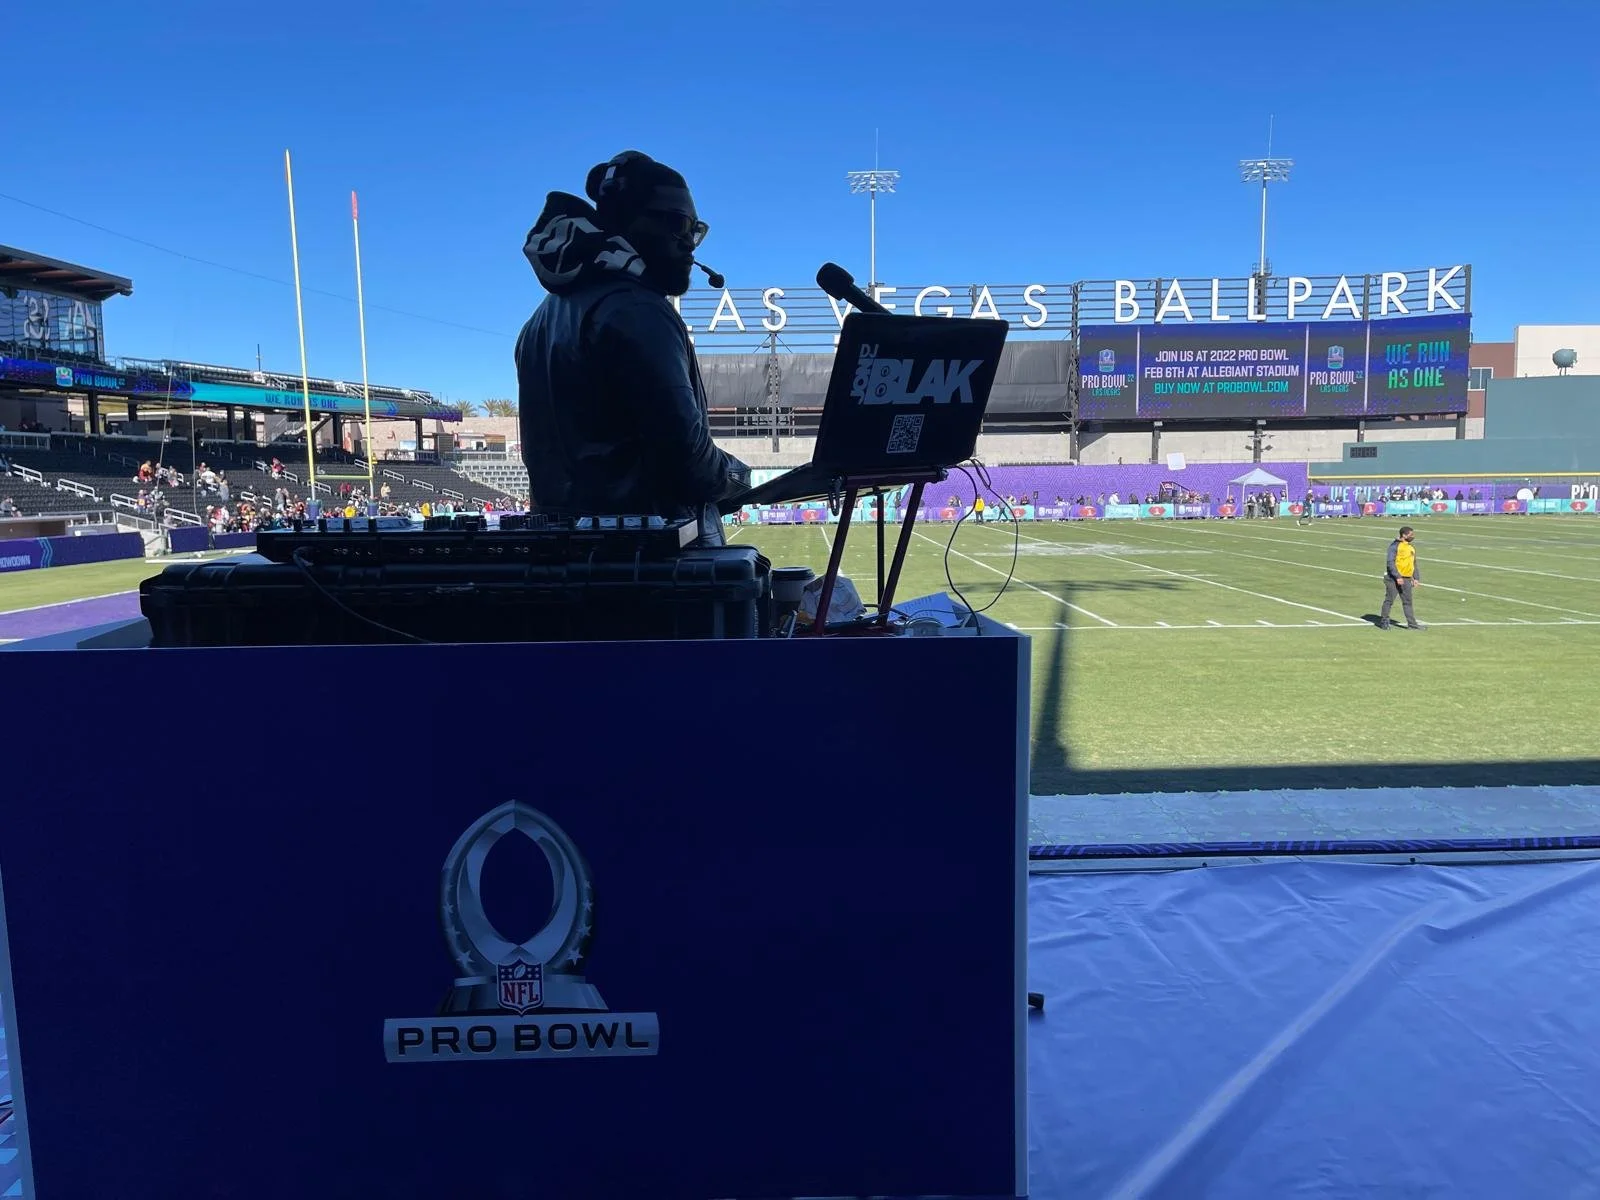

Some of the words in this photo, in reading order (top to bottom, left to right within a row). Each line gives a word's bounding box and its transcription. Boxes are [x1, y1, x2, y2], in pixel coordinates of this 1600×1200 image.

[1114, 264, 1463, 323] BALLPARK
[859, 343, 879, 358] DJ
[1155, 350, 1178, 362] JOIN
[1180, 350, 1194, 362] US
[1196, 350, 1208, 362] AT
[1210, 350, 1236, 362] 2022
[1238, 349, 1258, 361] PRO
[1260, 348, 1289, 361] BOWL
[1386, 343, 1412, 365] WE
[1418, 340, 1450, 364] RUN
[74, 373, 93, 386] PRO
[1144, 366, 1163, 379] FEB
[1165, 366, 1185, 378] 6TH
[1187, 366, 1199, 378] AT
[1201, 365, 1254, 378] ALLEGIANT
[1256, 364, 1300, 377] STADIUM
[1309, 371, 1328, 386] PRO
[1330, 370, 1357, 385] BOWL
[1388, 368, 1409, 389] AS
[1413, 366, 1445, 388] ONE
[863, 358, 985, 405] BLAK
[1081, 374, 1100, 389] PRO
[1101, 374, 1129, 389] BOWL
[1154, 382, 1175, 394] BUY
[1177, 382, 1201, 394] NOW
[1202, 382, 1215, 394] AT
[1217, 380, 1289, 394] PROBOWL.COM
[265, 393, 281, 404] WE
[321, 399, 339, 410] ONE
[502, 980, 539, 1003] NFL
[397, 1025, 497, 1055] PRO
[513, 1022, 650, 1052] BOWL
